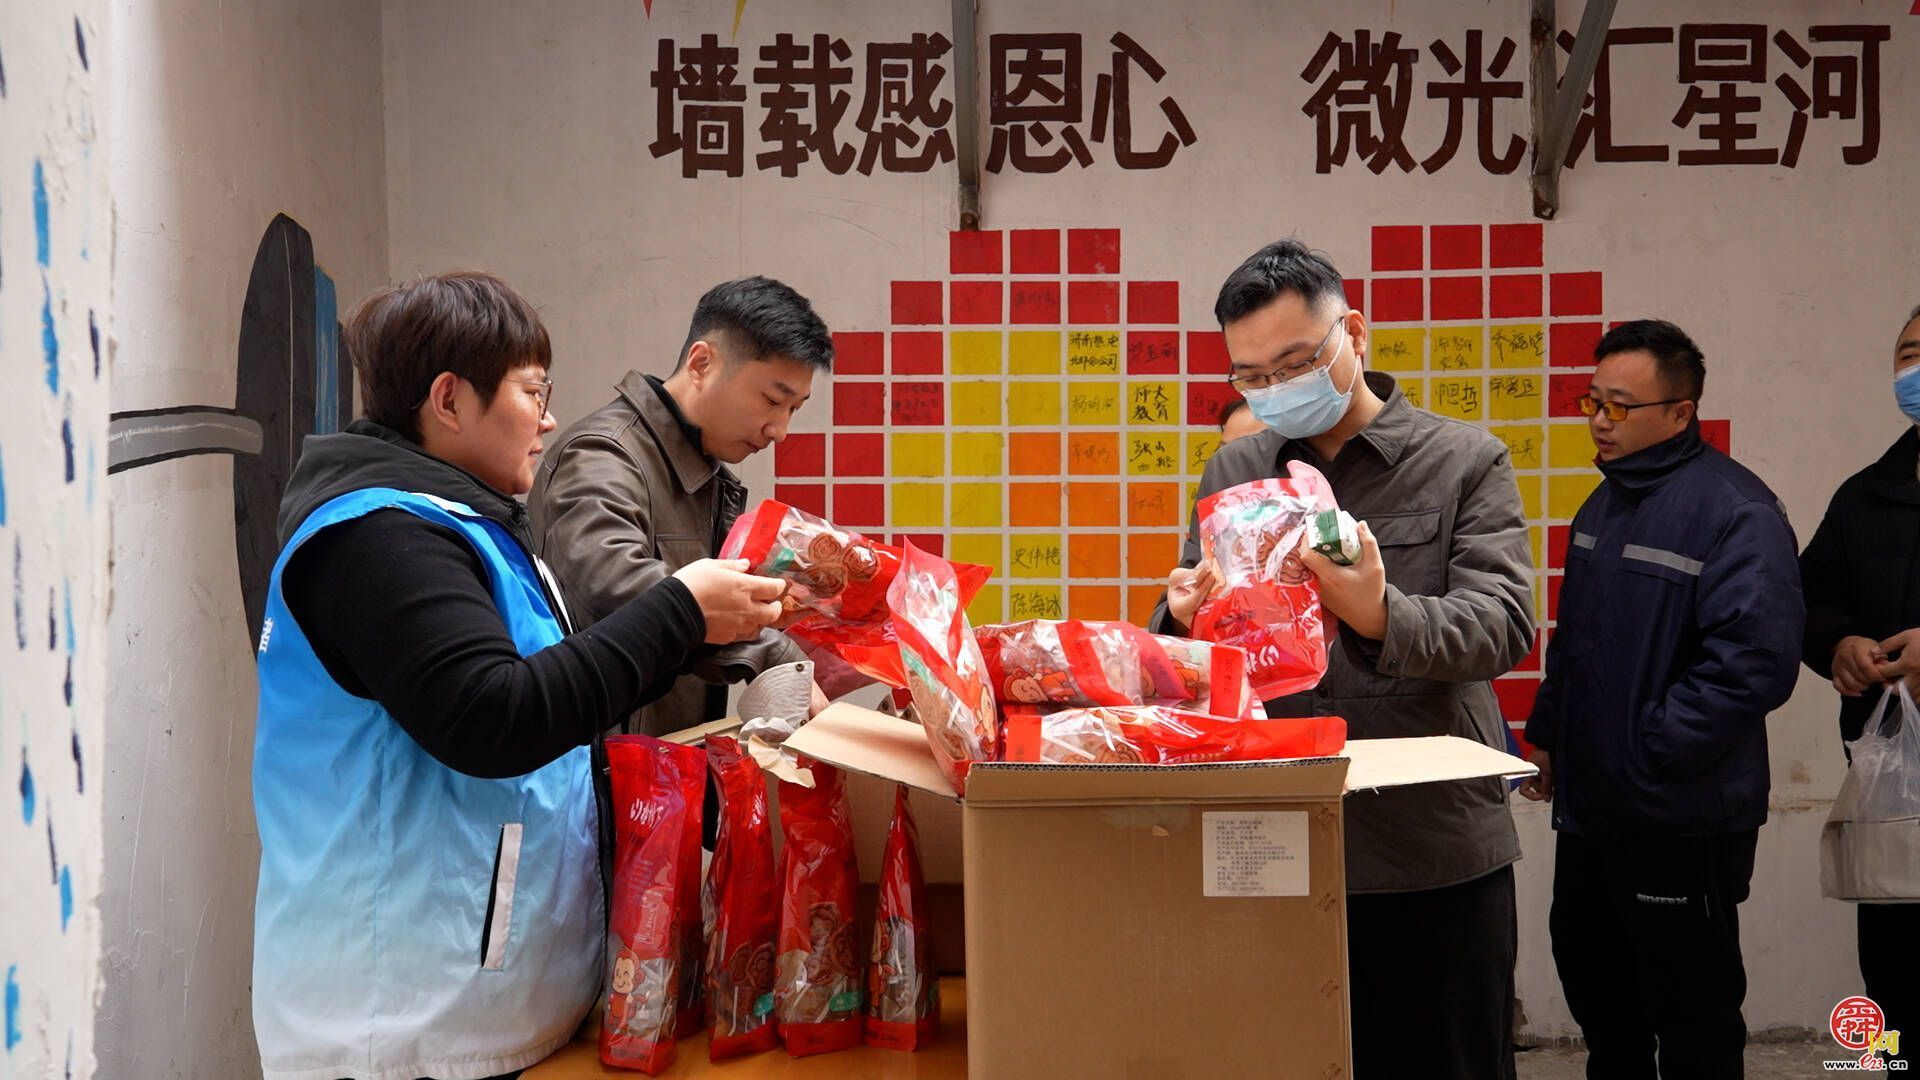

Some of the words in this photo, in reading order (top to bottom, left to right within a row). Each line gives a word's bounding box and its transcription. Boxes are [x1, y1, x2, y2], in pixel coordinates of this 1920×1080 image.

[648, 31, 1197, 178] 墙载感恩心
[1301, 24, 1891, 175] 微光汇星河
